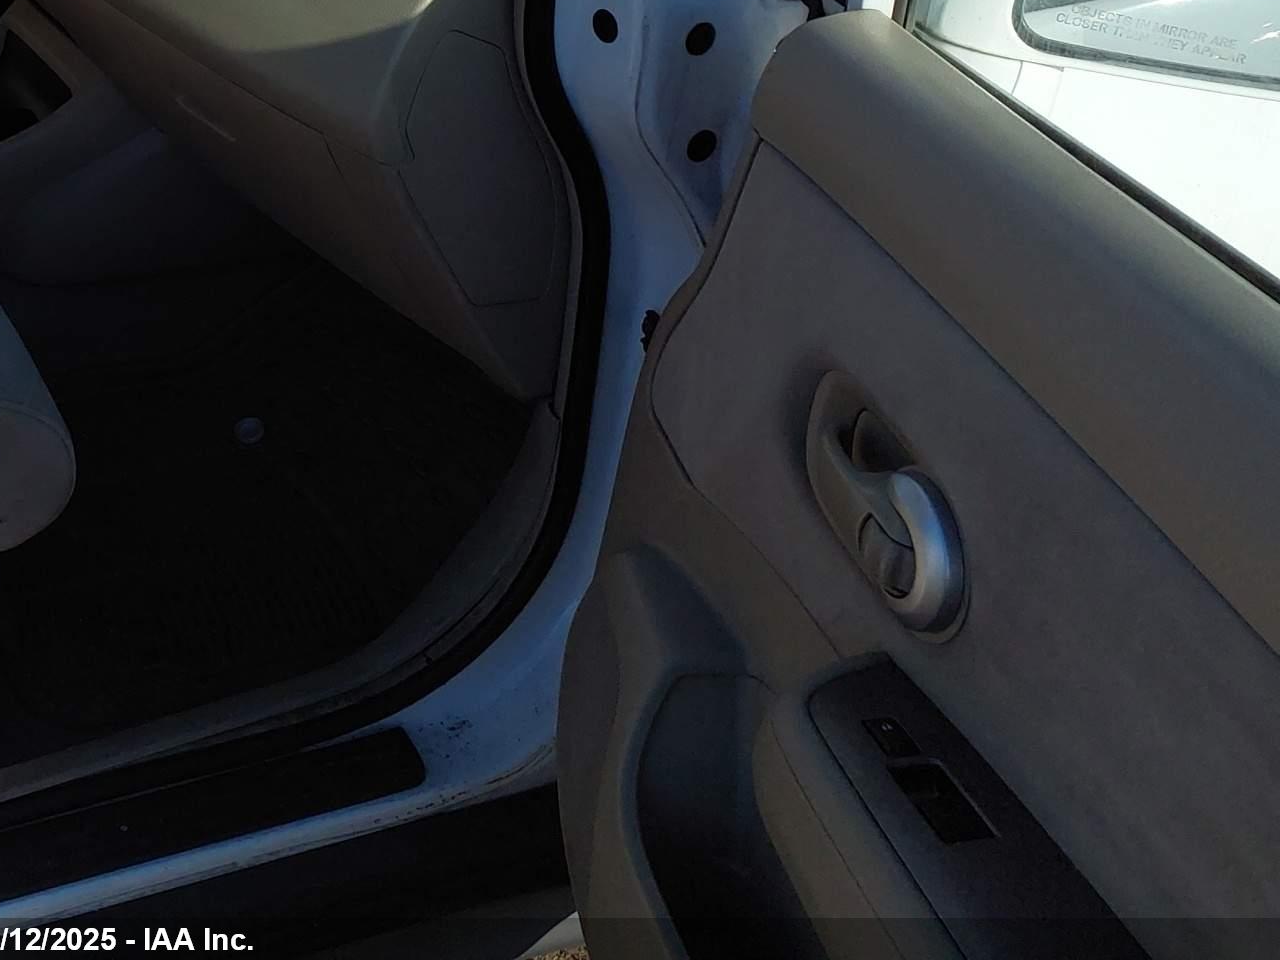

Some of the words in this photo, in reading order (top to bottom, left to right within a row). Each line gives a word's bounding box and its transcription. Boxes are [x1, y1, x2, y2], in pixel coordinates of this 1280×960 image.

[1056, 12, 1108, 33] CLOSER
[1072, 4, 1133, 25] OBJECTS
[1152, 21, 1208, 43] MIRROR
[1210, 35, 1239, 49] ARE
